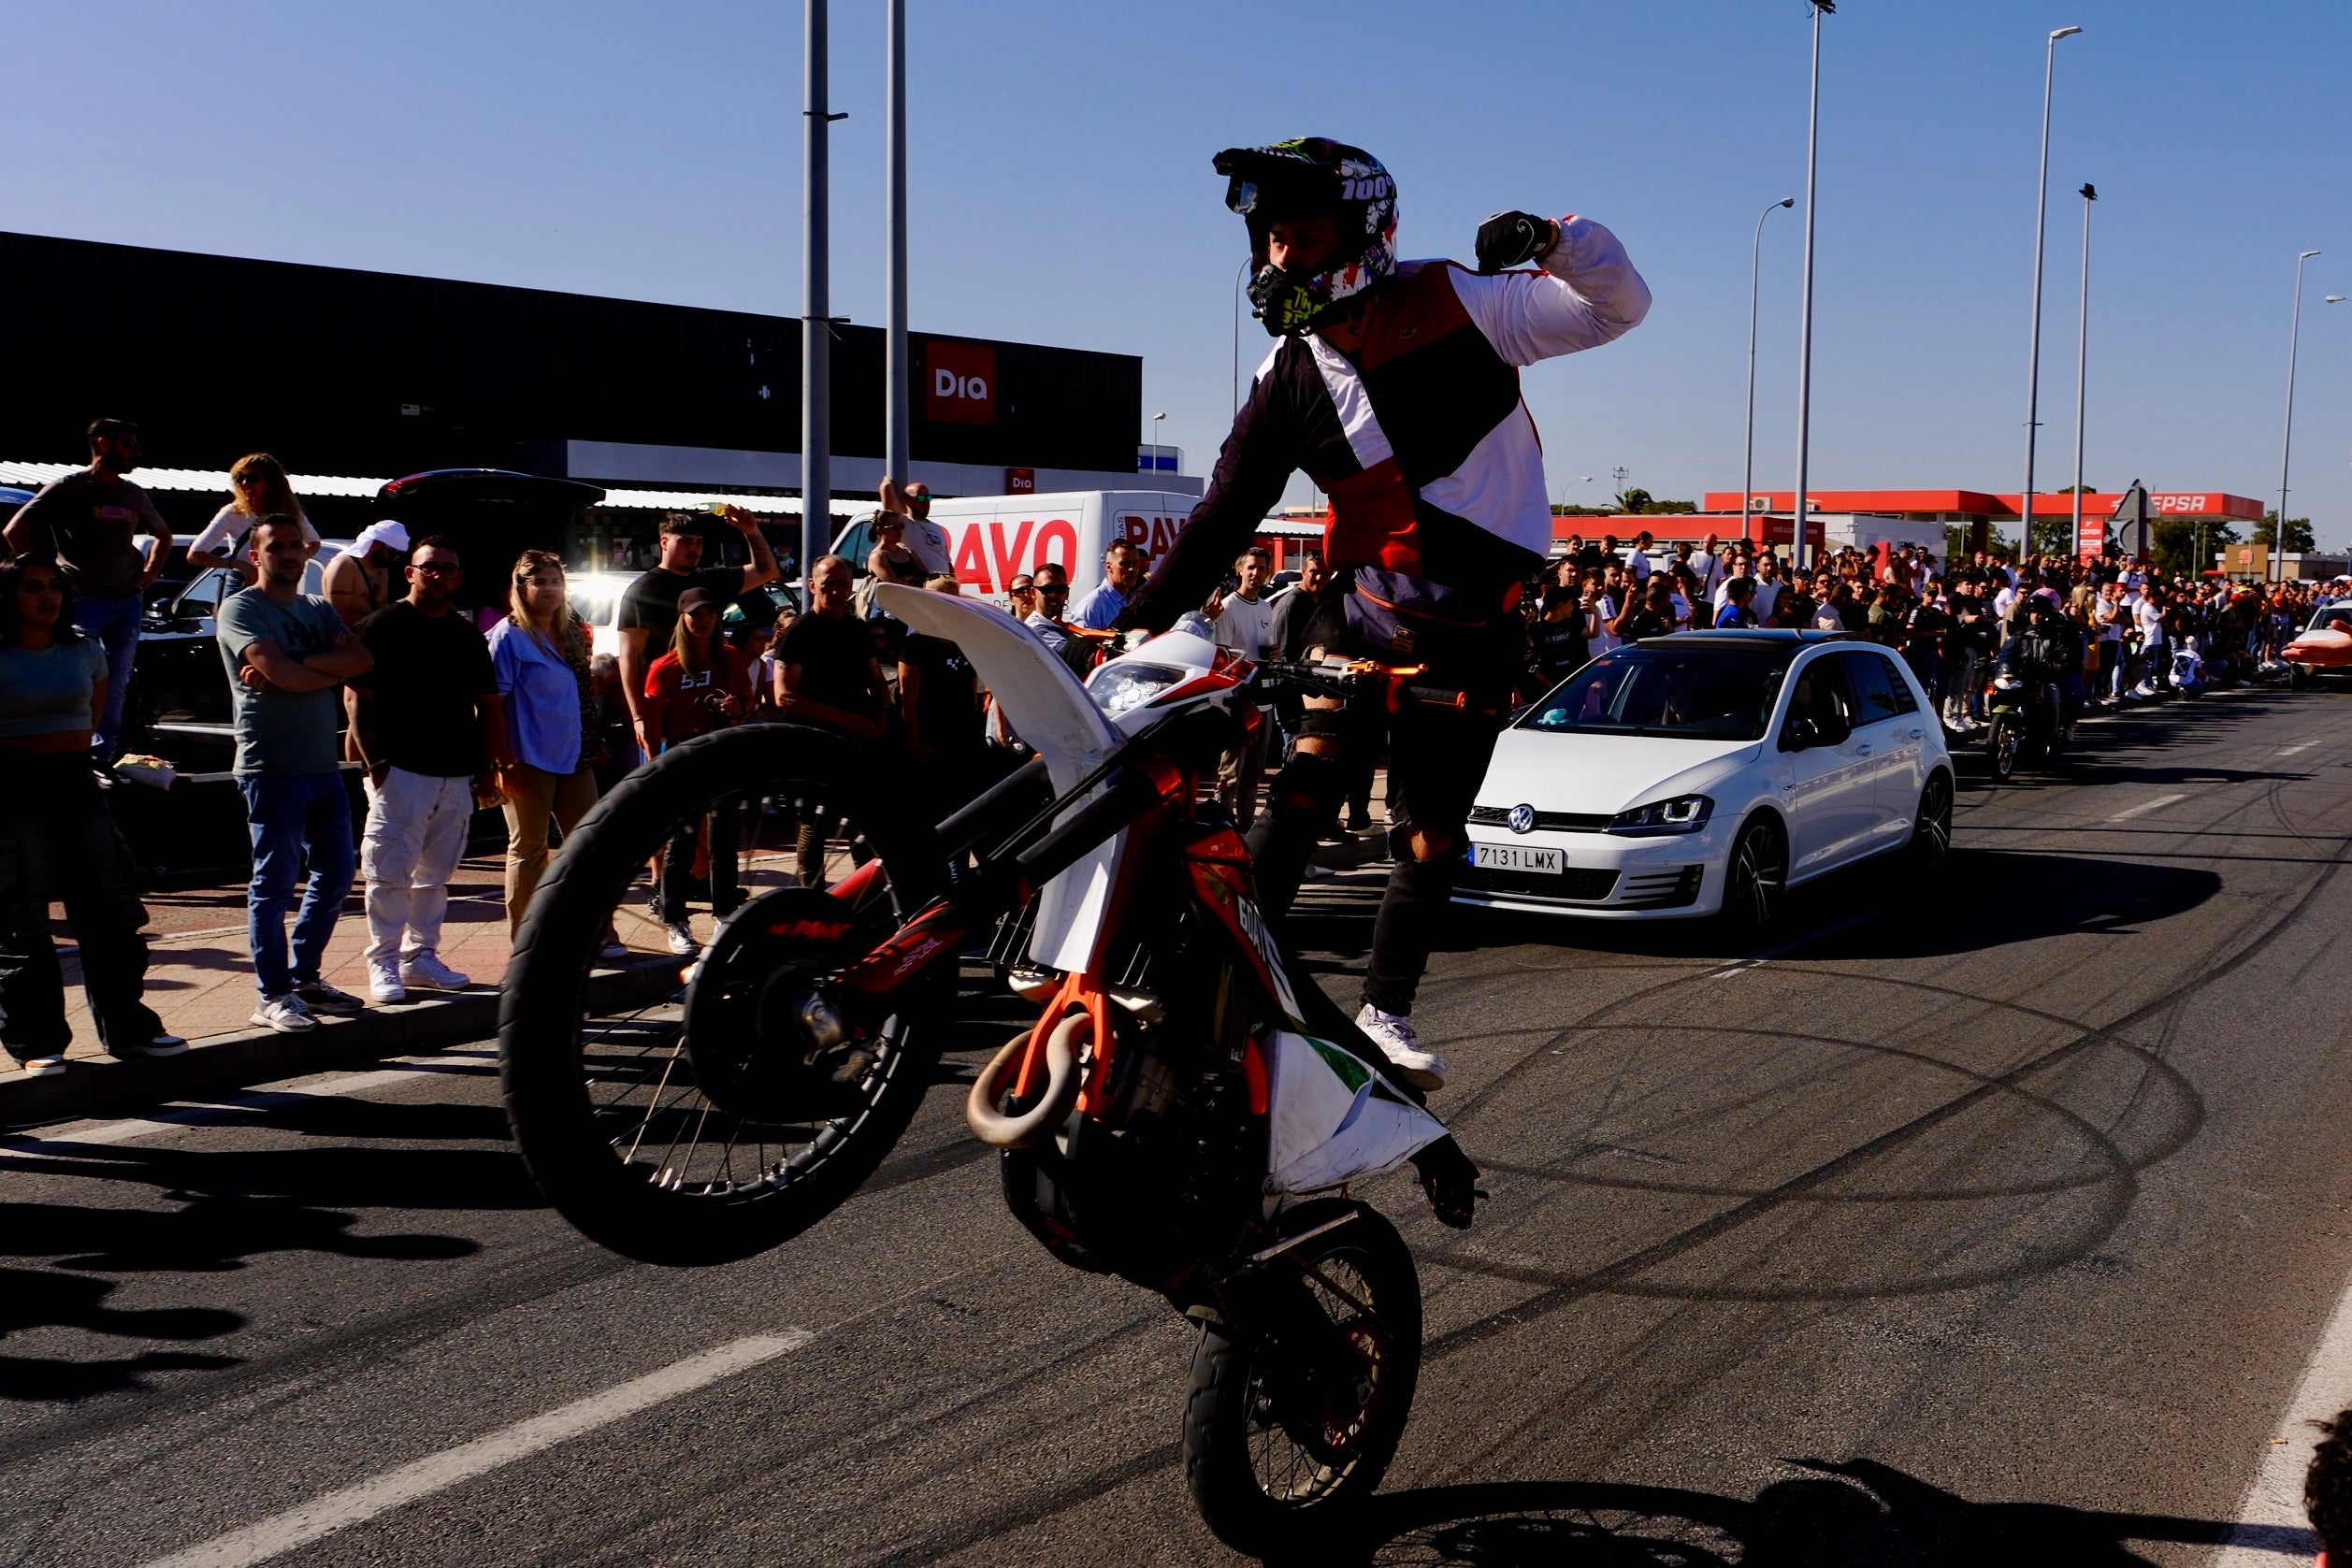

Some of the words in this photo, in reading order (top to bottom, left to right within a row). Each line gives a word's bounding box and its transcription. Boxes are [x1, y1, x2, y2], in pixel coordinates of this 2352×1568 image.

[935, 368, 988, 400] Dia
[1013, 477, 1032, 489] Dia
[2150, 496, 2206, 511] EPSA
[1117, 516, 1126, 539] DAS
[1124, 516, 1187, 561] PAV
[942, 519, 1078, 596] AVO
[1480, 847, 1517, 867] 7131
[1524, 851, 1555, 870] LMX
